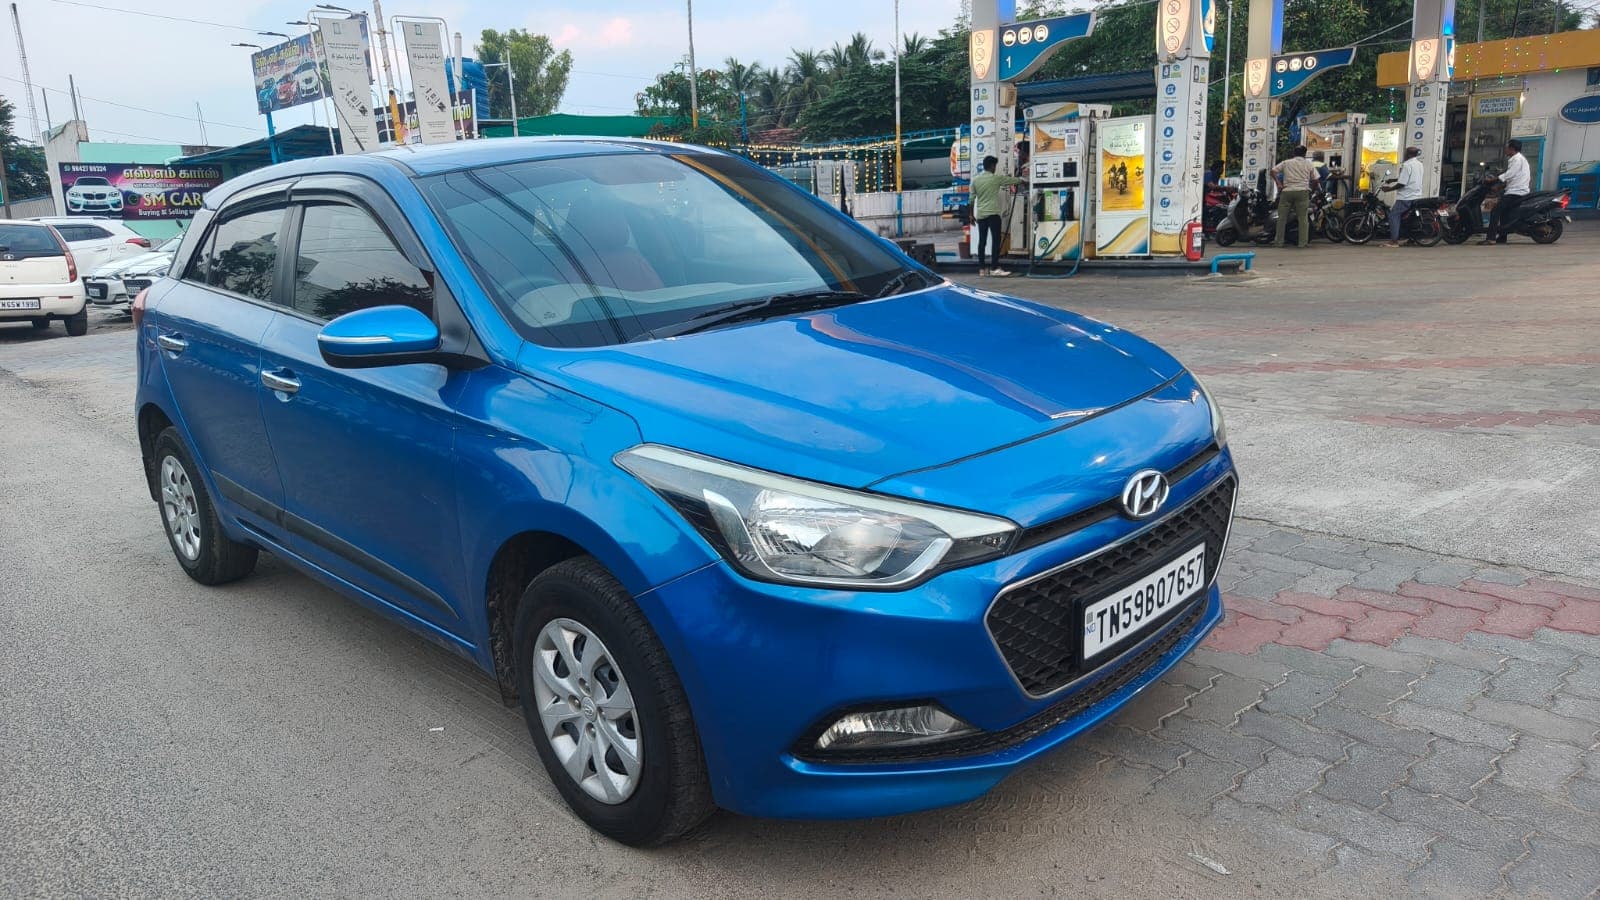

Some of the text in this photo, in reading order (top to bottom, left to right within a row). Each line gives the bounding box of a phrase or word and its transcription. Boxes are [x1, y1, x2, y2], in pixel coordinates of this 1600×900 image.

[1005, 55, 1011, 69] 1
[1277, 79, 1284, 90] 3
[143, 192, 204, 207] SM CAR
[168, 208, 189, 216] Selling
